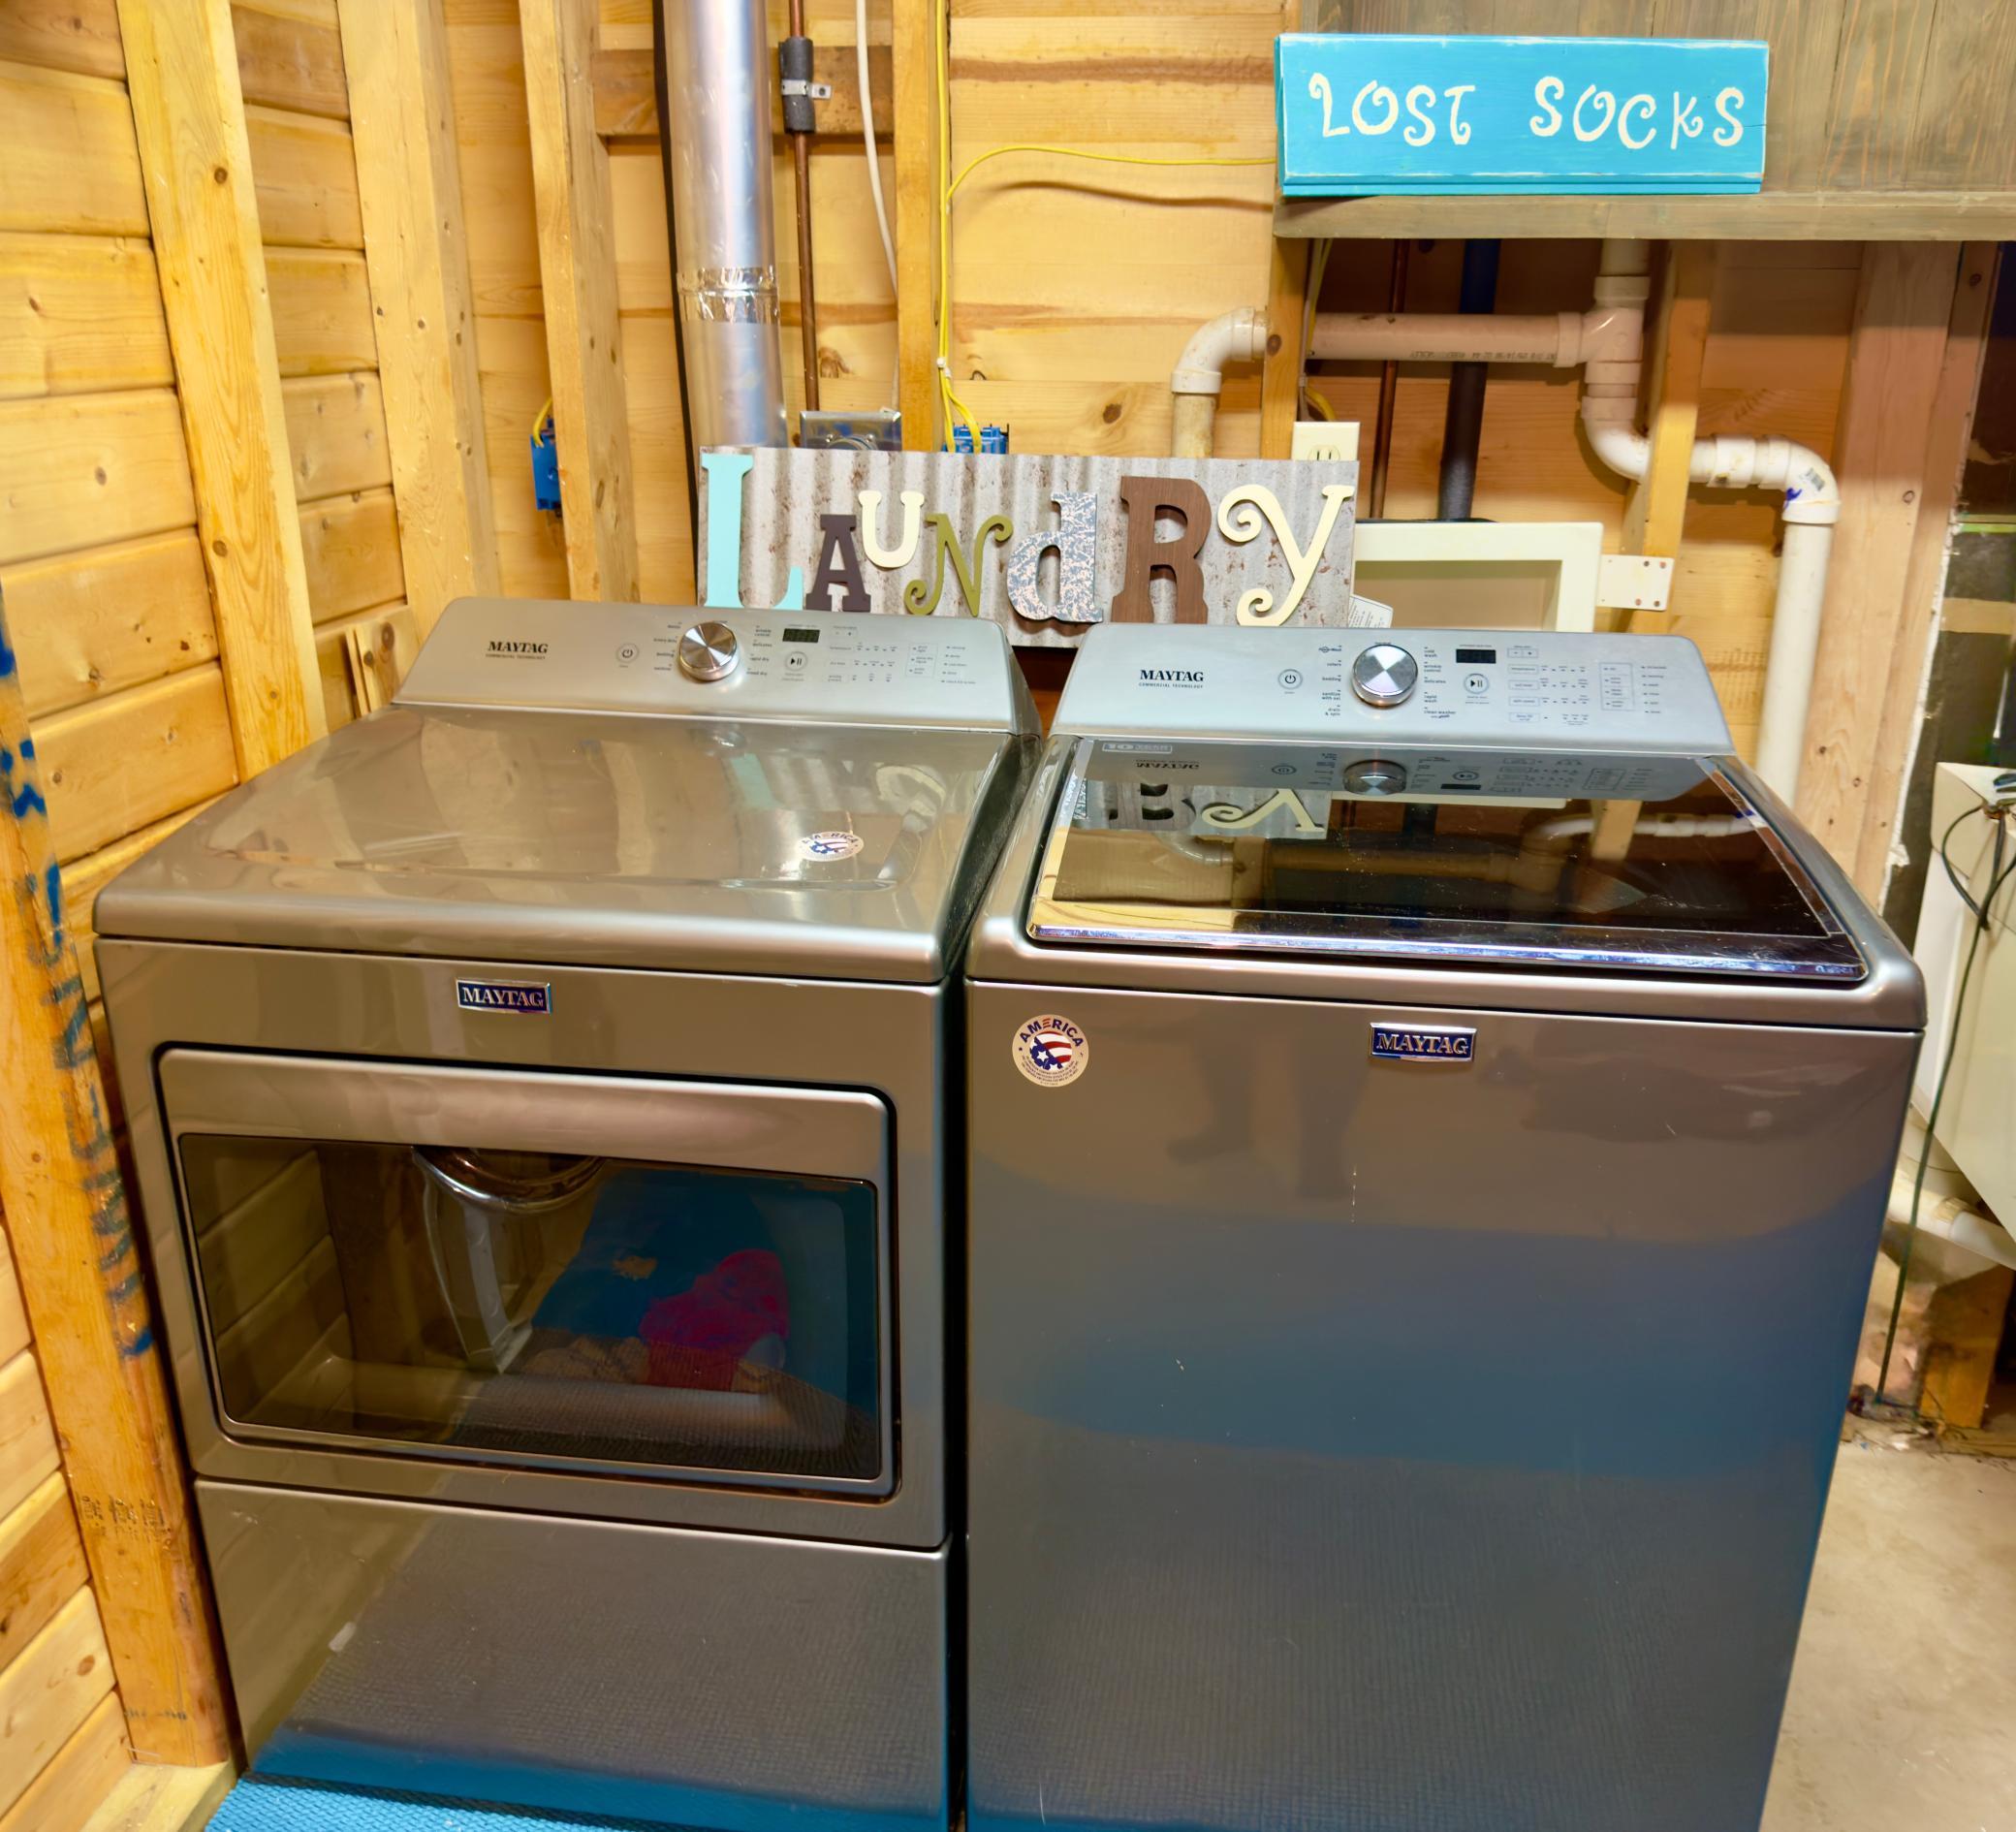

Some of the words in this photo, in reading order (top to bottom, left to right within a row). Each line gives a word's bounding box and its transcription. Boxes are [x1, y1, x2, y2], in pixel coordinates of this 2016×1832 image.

[1307, 72, 1476, 146] LOST
[1528, 76, 1746, 150] SOCKS
[488, 641, 549, 654] MAYTAG
[1139, 669, 1205, 682] MAYTAG
[461, 986, 544, 1008] MAYTAG
[1019, 1017, 1085, 1048] AMERICA
[1375, 1032, 1469, 1055] MAYTAG
